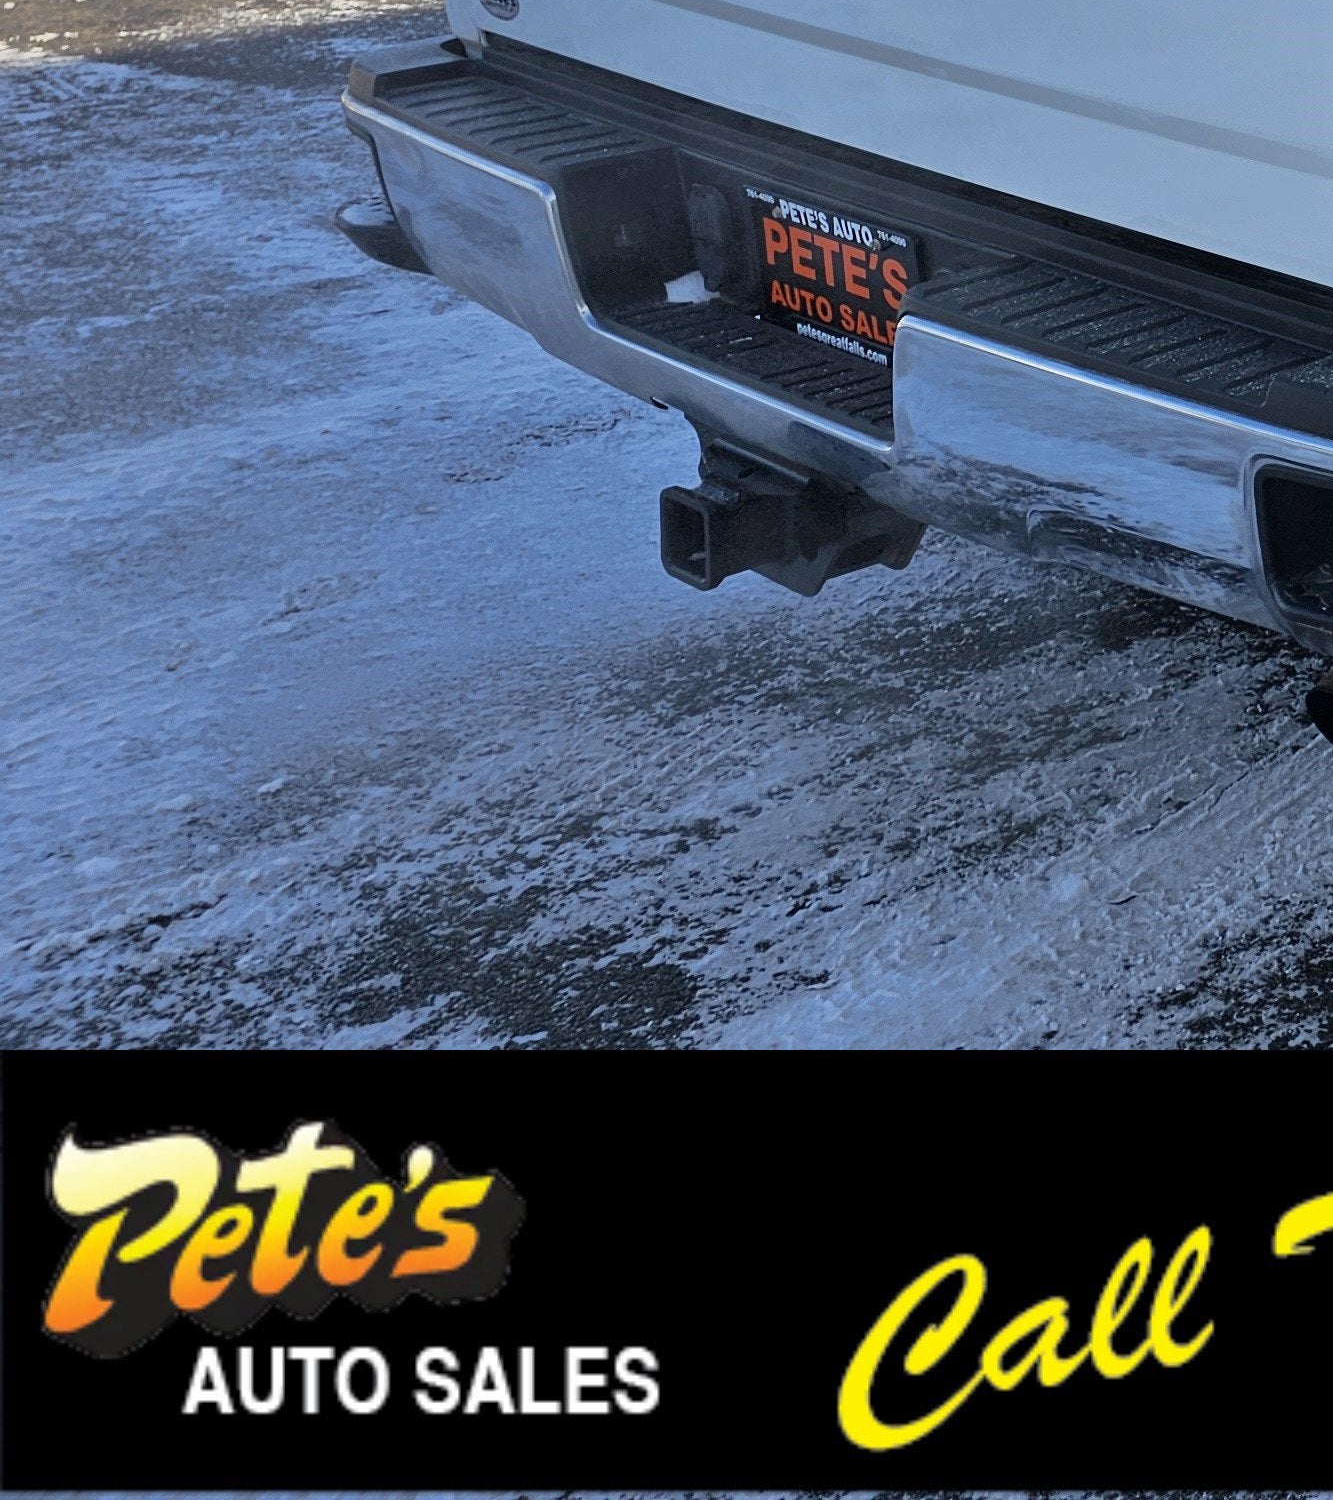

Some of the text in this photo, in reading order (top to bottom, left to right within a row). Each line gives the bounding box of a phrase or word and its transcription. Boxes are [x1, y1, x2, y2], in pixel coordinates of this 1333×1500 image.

[779, 199, 873, 247] PETE'S AUTO
[763, 217, 908, 310] PETE'S
[771, 280, 897, 347] AUTO SALE
[796, 322, 888, 367] petesgreatfalls.com
